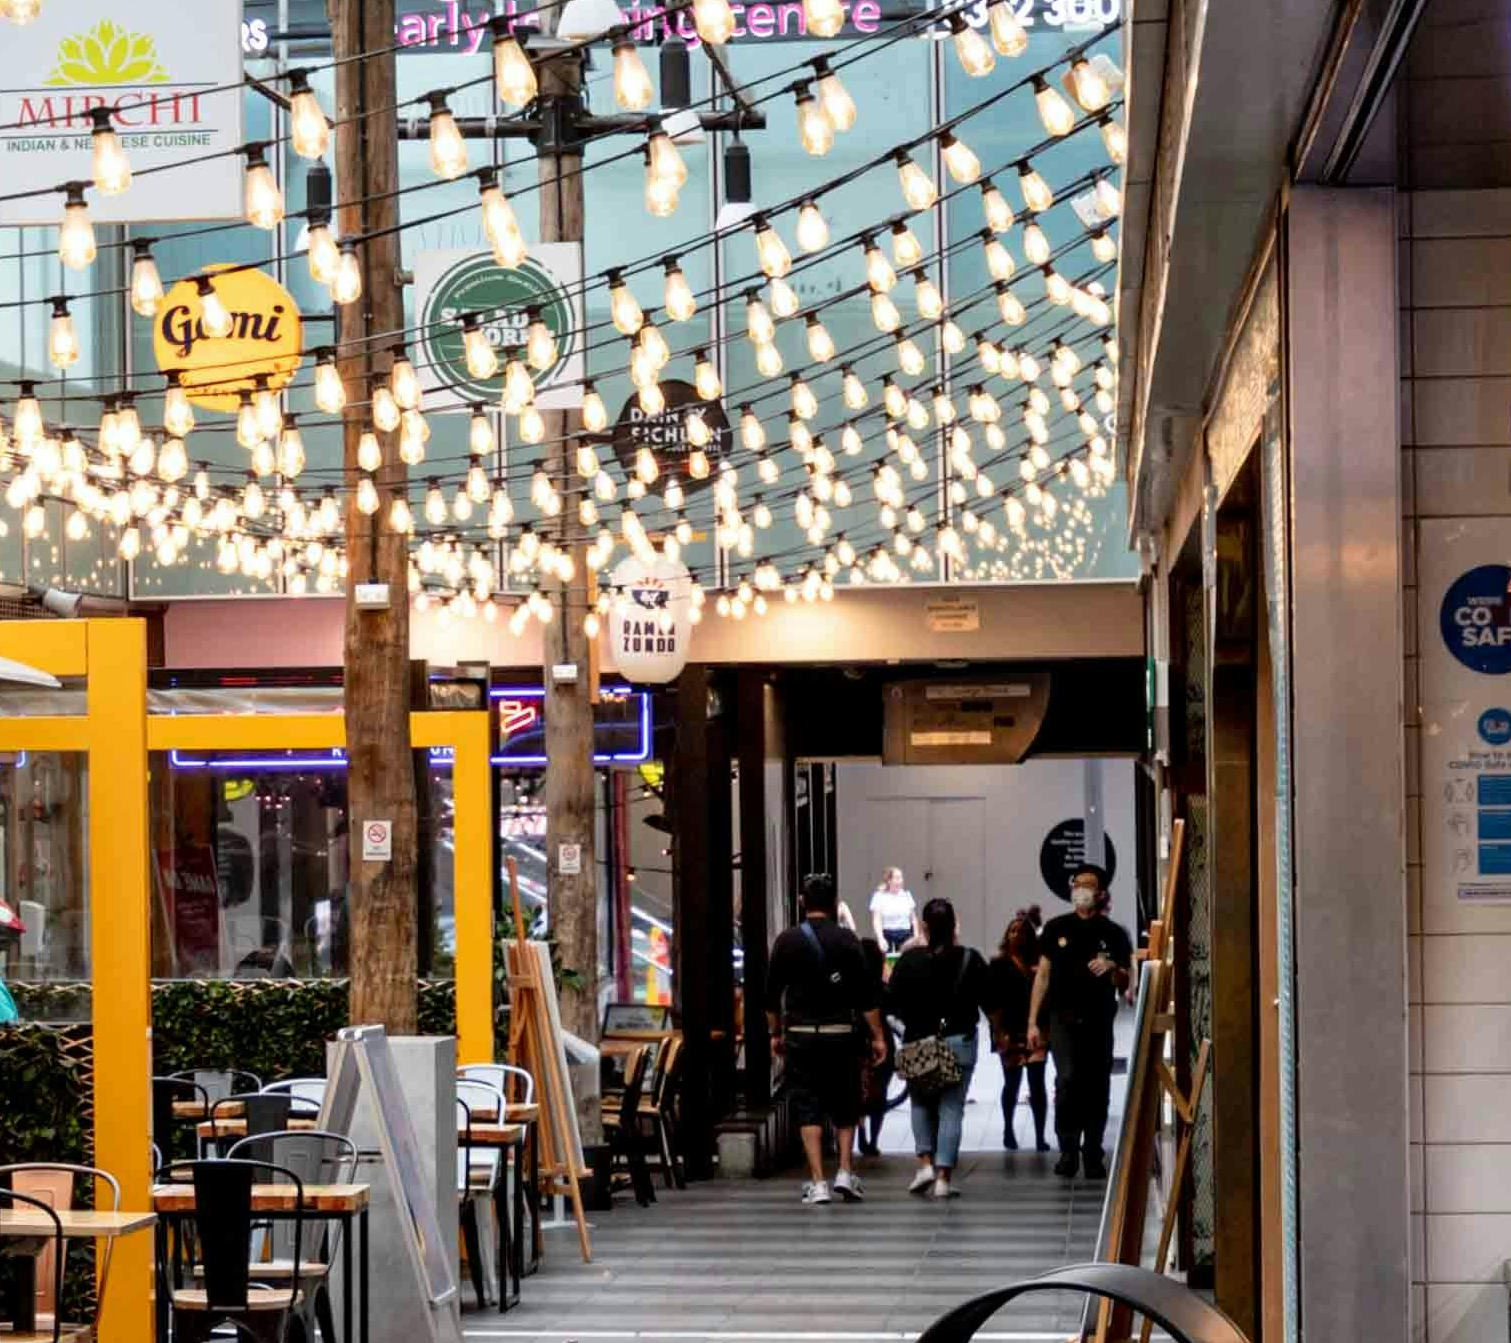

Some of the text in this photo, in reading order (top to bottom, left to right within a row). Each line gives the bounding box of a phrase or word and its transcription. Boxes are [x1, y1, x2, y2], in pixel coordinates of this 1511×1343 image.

[6, 133, 211, 153] INDIAN & NEESE CUISINE
[440, 306, 529, 328] SAD
[623, 619, 675, 635] RAM
